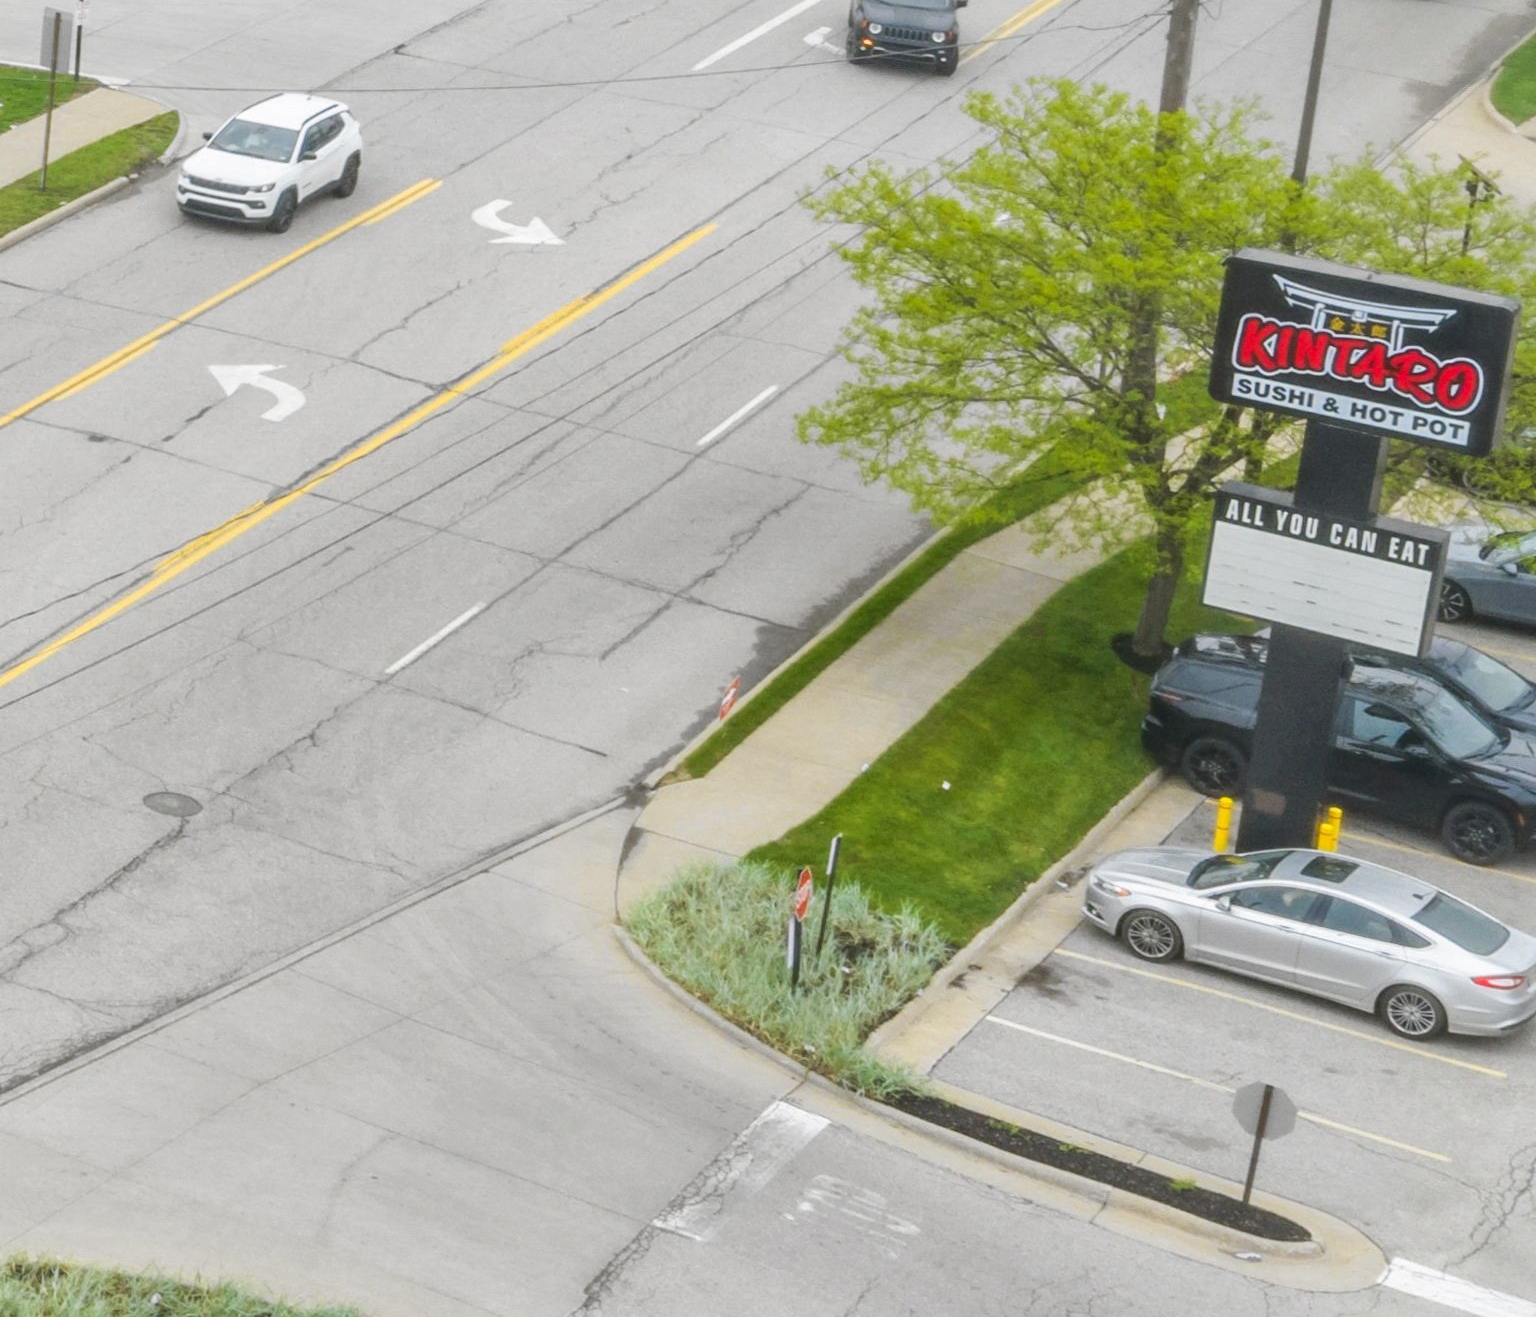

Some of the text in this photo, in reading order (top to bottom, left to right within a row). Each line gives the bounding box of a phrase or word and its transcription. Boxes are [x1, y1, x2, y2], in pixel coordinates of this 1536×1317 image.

[1235, 315, 1482, 412] KINTARO
[1237, 378, 1465, 441] SUSHI & HOT POT
[1225, 499, 1431, 566] ALL YOU CAN EAT
